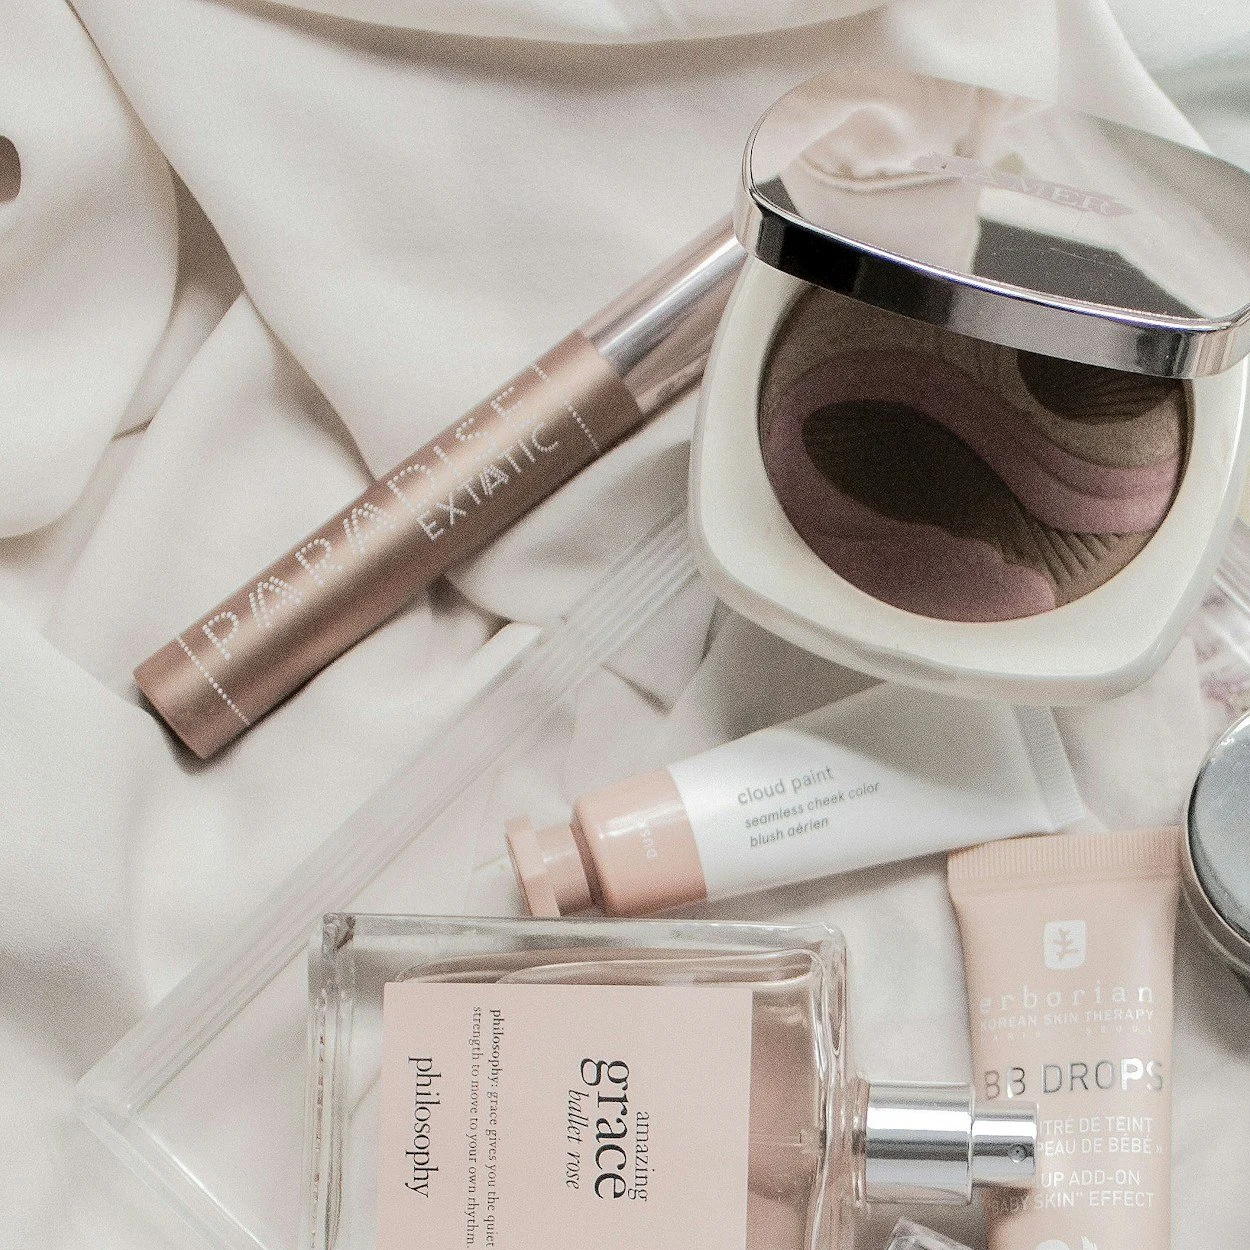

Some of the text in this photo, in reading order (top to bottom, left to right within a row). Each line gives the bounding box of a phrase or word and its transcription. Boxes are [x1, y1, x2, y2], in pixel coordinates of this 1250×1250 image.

[416, 417, 559, 542] EXTATIC
[200, 384, 530, 661] PARADISE
[737, 765, 834, 805] cloud paint
[744, 782, 880, 829] seamless cheek color
[749, 827, 785, 848] blush
[979, 979, 1154, 1015] erborian
[1044, 1011, 1079, 1025] SKIN
[1085, 1008, 1155, 1022] THERAPY
[982, 1057, 1164, 1101] BB DROPS
[404, 1055, 442, 1199] philosophy
[463, 1006, 484, 1249] strength to move to your own rhythm.
[483, 1009, 505, 1248] philosophy: grace gives you the quiet
[565, 1088, 590, 1190] ballet rose
[580, 1057, 630, 1200] grace
[1079, 1116, 1101, 1133] DE
[1105, 1116, 1154, 1134] TEINT
[1081, 1136, 1102, 1154] DE
[1108, 1133, 1153, 1155] BÉBÉ
[627, 1111, 656, 1202] amazing
[1068, 1169, 1141, 1187] ADD-ON
[1088, 1189, 1155, 1209] EFFECT
